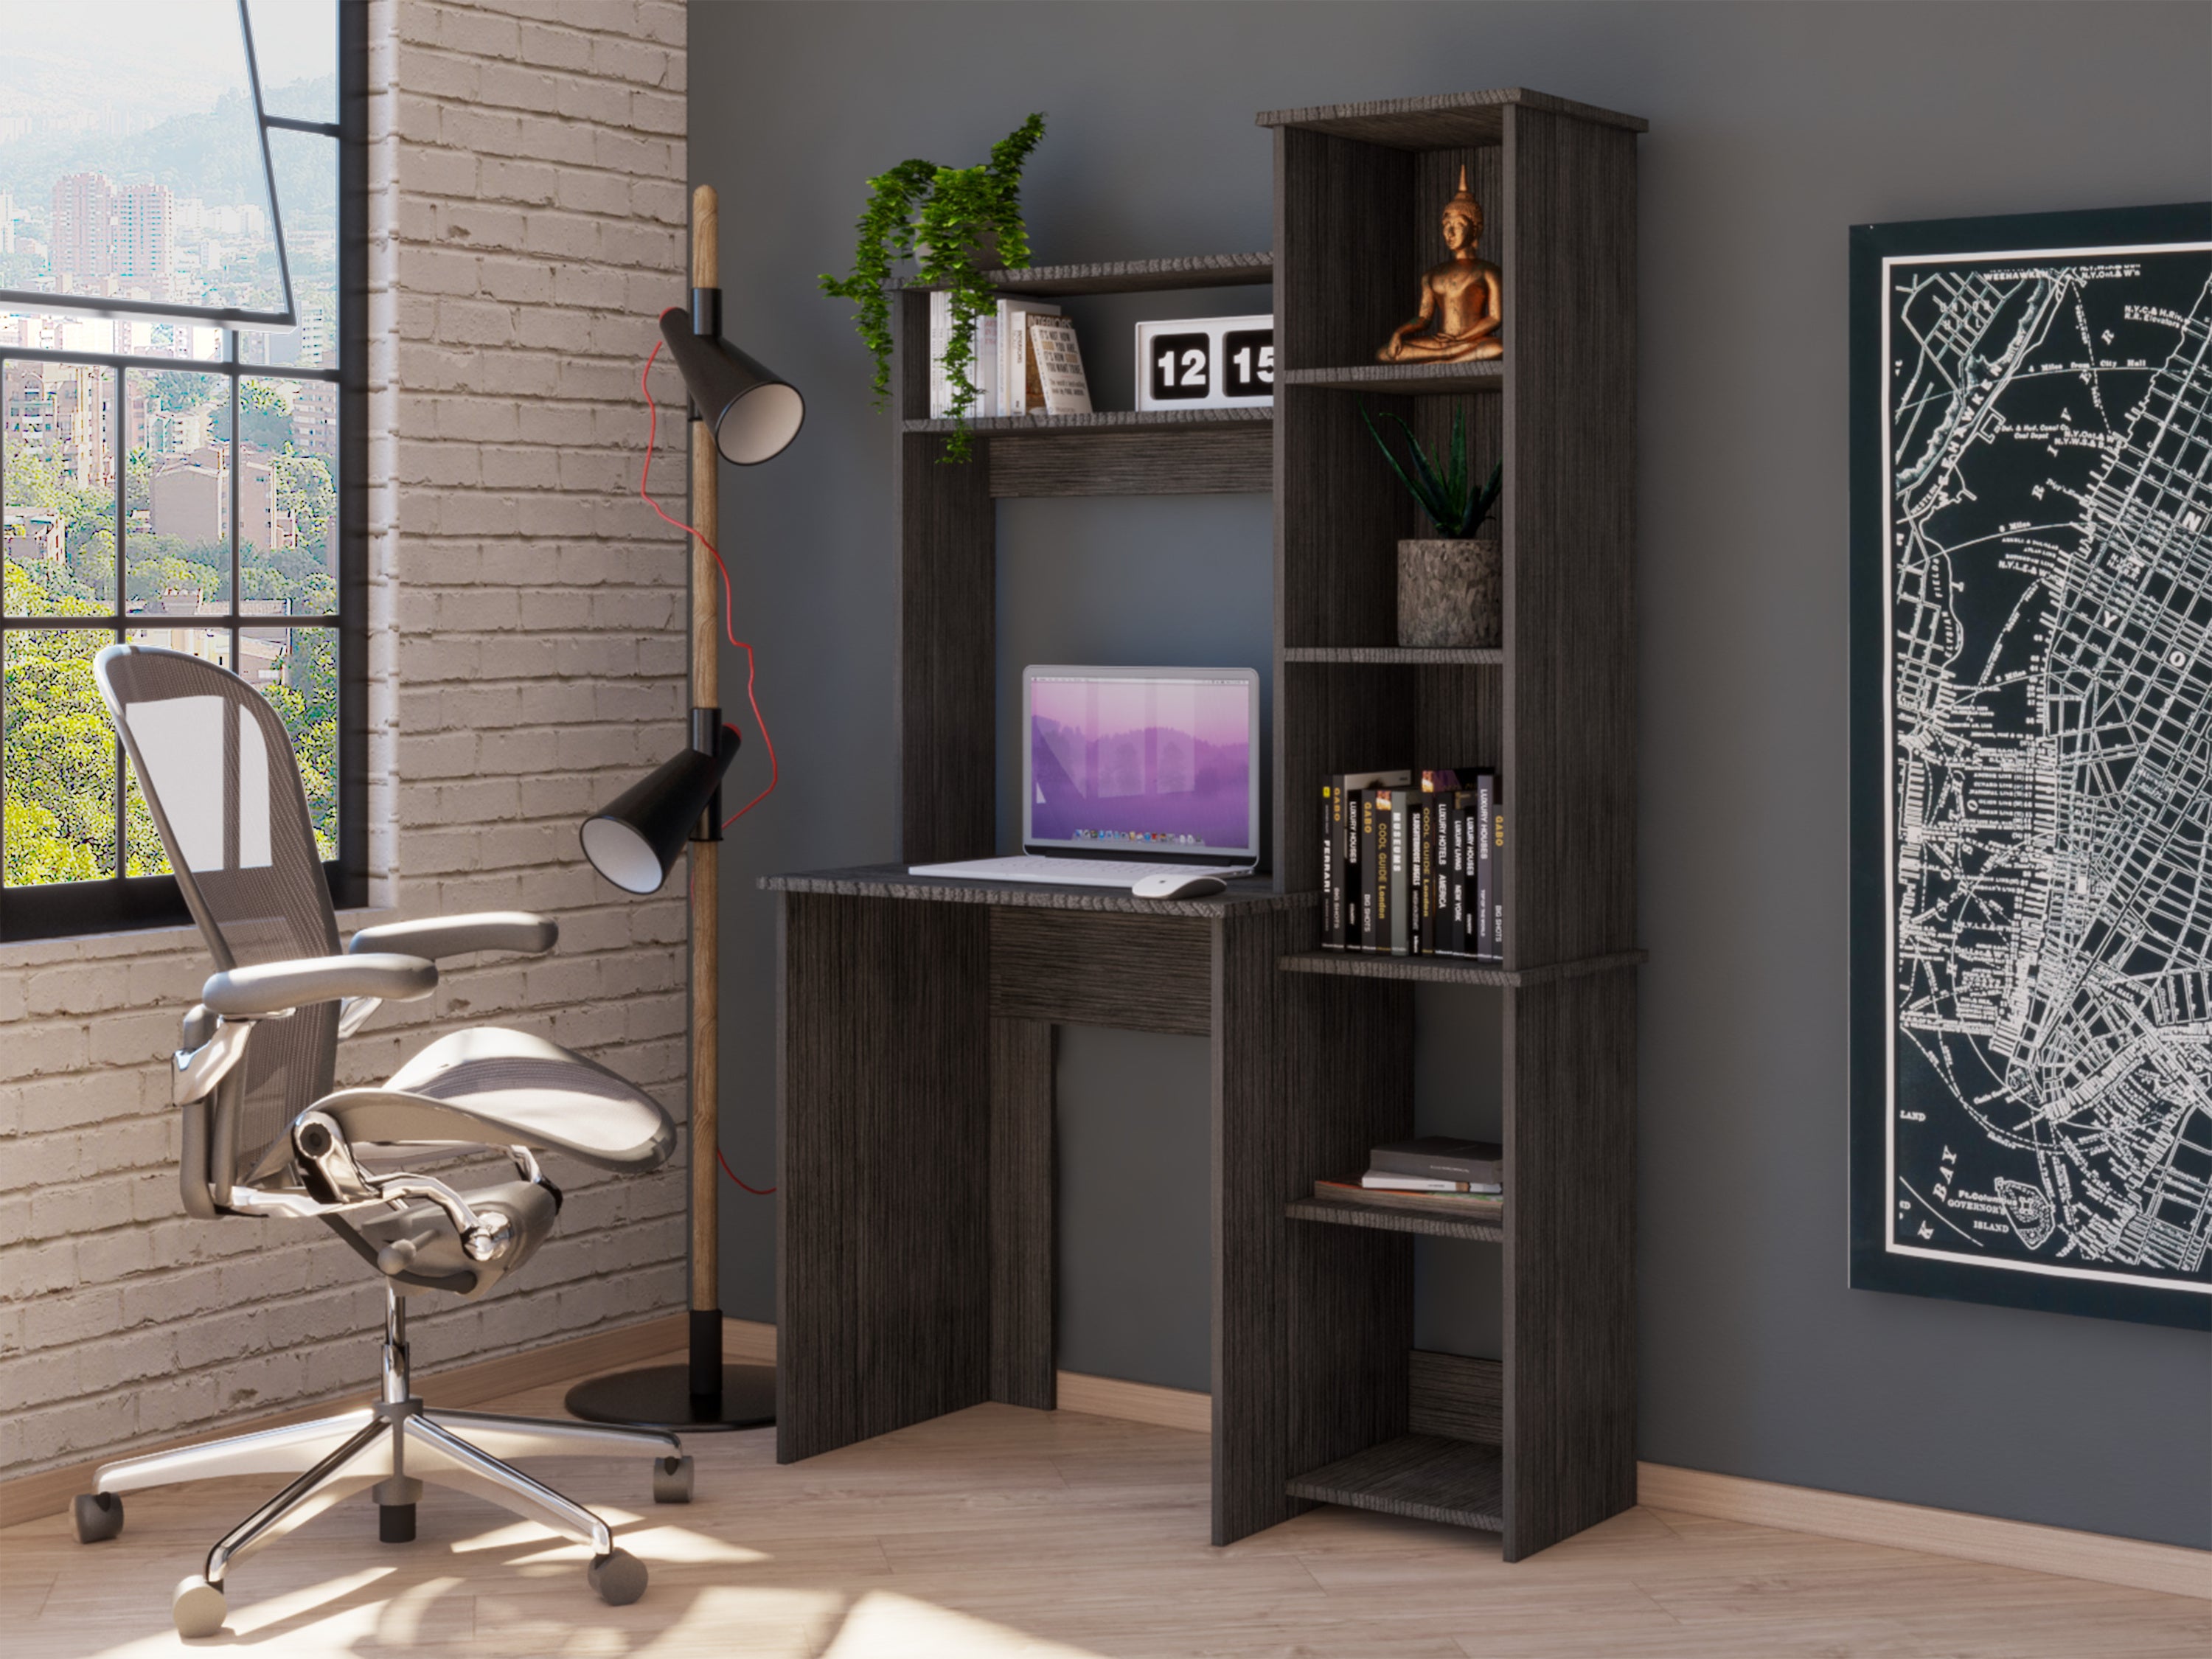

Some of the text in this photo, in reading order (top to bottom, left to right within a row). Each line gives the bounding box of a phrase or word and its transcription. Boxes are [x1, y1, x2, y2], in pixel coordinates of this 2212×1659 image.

[1158, 349, 1206, 386] 12
[1234, 347, 1274, 383] 15
[2100, 360, 2117, 368] City
[1333, 787, 1341, 822] GABO
[1349, 801, 1357, 832] LUXURY
[1480, 788, 1489, 823] LUXURY
[1349, 832, 1357, 863] HOUSES
[1392, 812, 1402, 872] MUSEUMS
[1413, 813, 1421, 863] SLAUGHTERHOUSE
[1454, 821, 1462, 849] LUXURY
[1466, 817, 1474, 846] LUXURY
[1480, 824, 1489, 860] HOUSES
[1363, 801, 1372, 933] GABO BIG SHOTS
[1377, 823, 1387, 919] COOL GUIDE London
[1439, 803, 1447, 908] LUXURY HOTELS AMERICA
[1413, 863, 1421, 886] ANGELS
[1495, 815, 1503, 942] GABO BIG SHOTS
[1899, 1110, 1926, 1122] LAND
[1932, 1144, 1957, 1203] BAY
[1973, 1221, 2009, 1234] ISLAND
